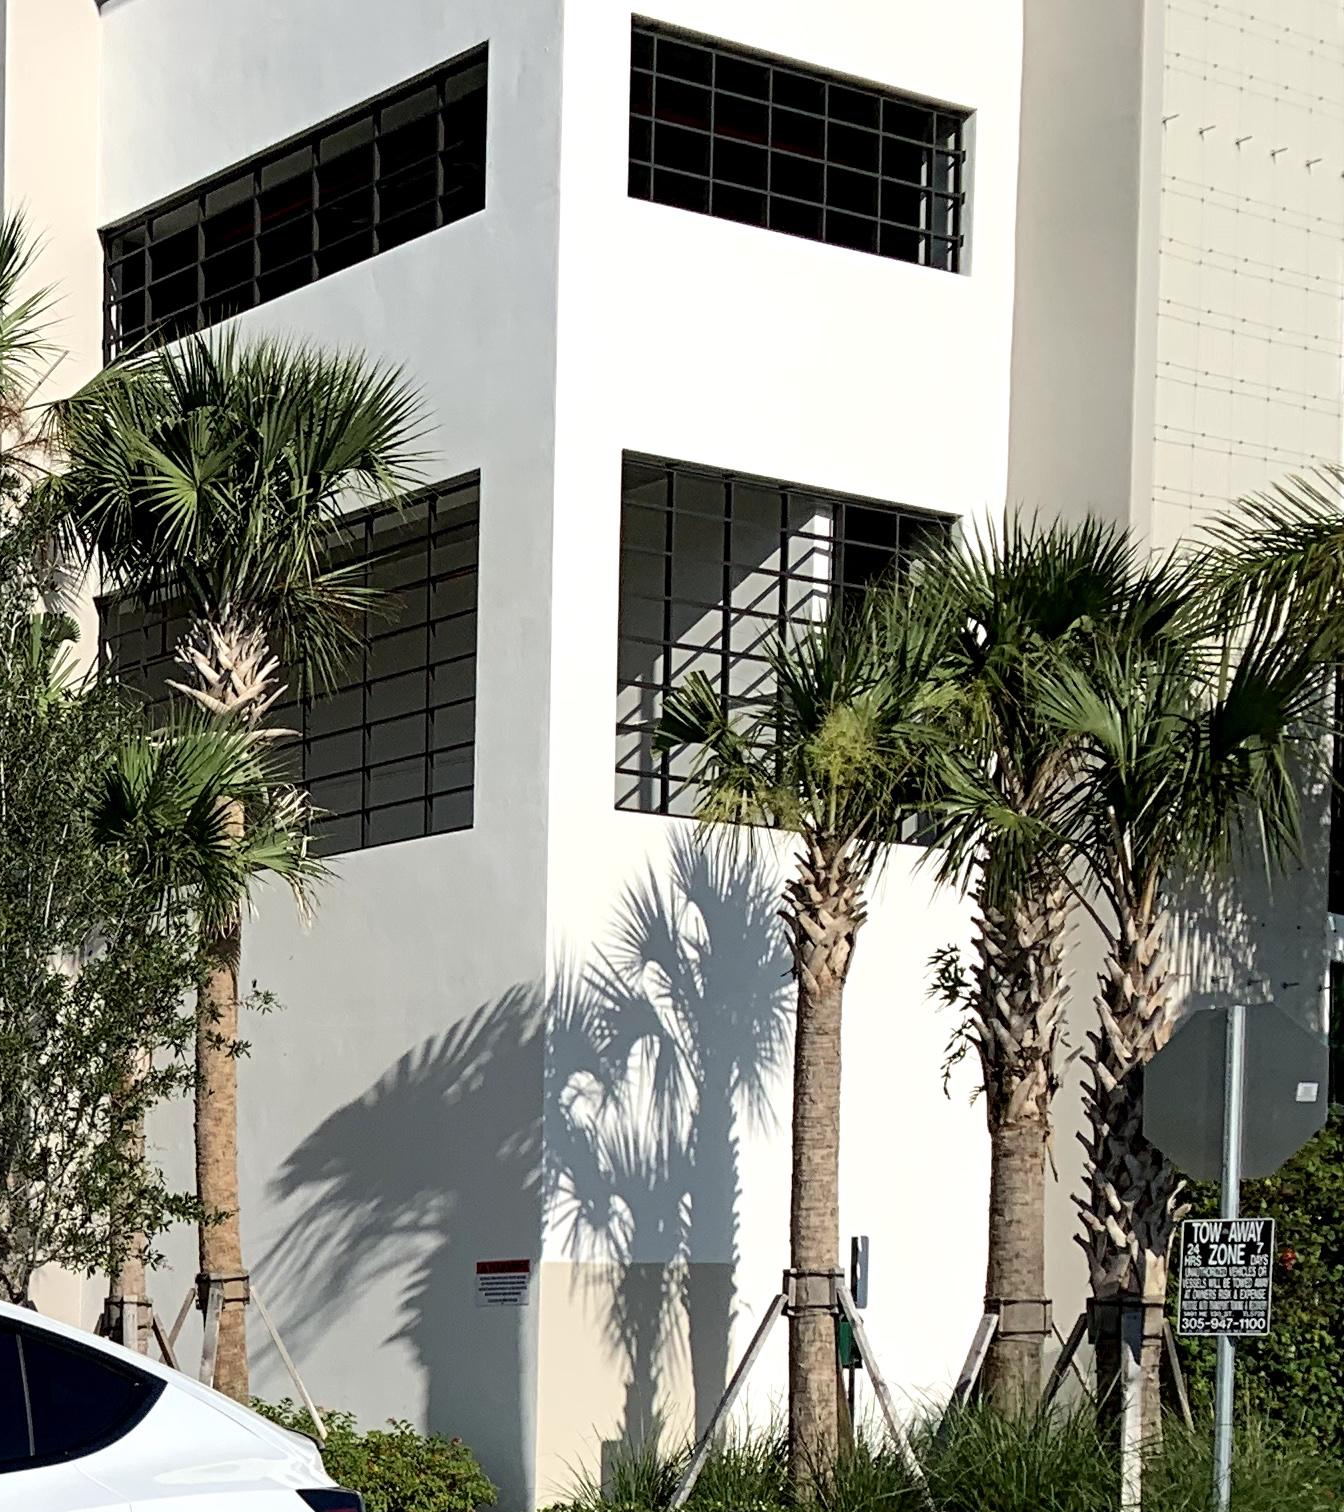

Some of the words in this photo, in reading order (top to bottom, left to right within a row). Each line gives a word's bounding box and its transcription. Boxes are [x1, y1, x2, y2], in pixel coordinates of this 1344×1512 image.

[1187, 1243, 1200, 1255] 24
[1208, 1243, 1247, 1265] ZONE
[1256, 1242, 1265, 1254] 7
[1184, 1255, 1203, 1267] HRS
[1250, 1254, 1269, 1266] DAYS
[1181, 1317, 1266, 1330] 305-947-1100
